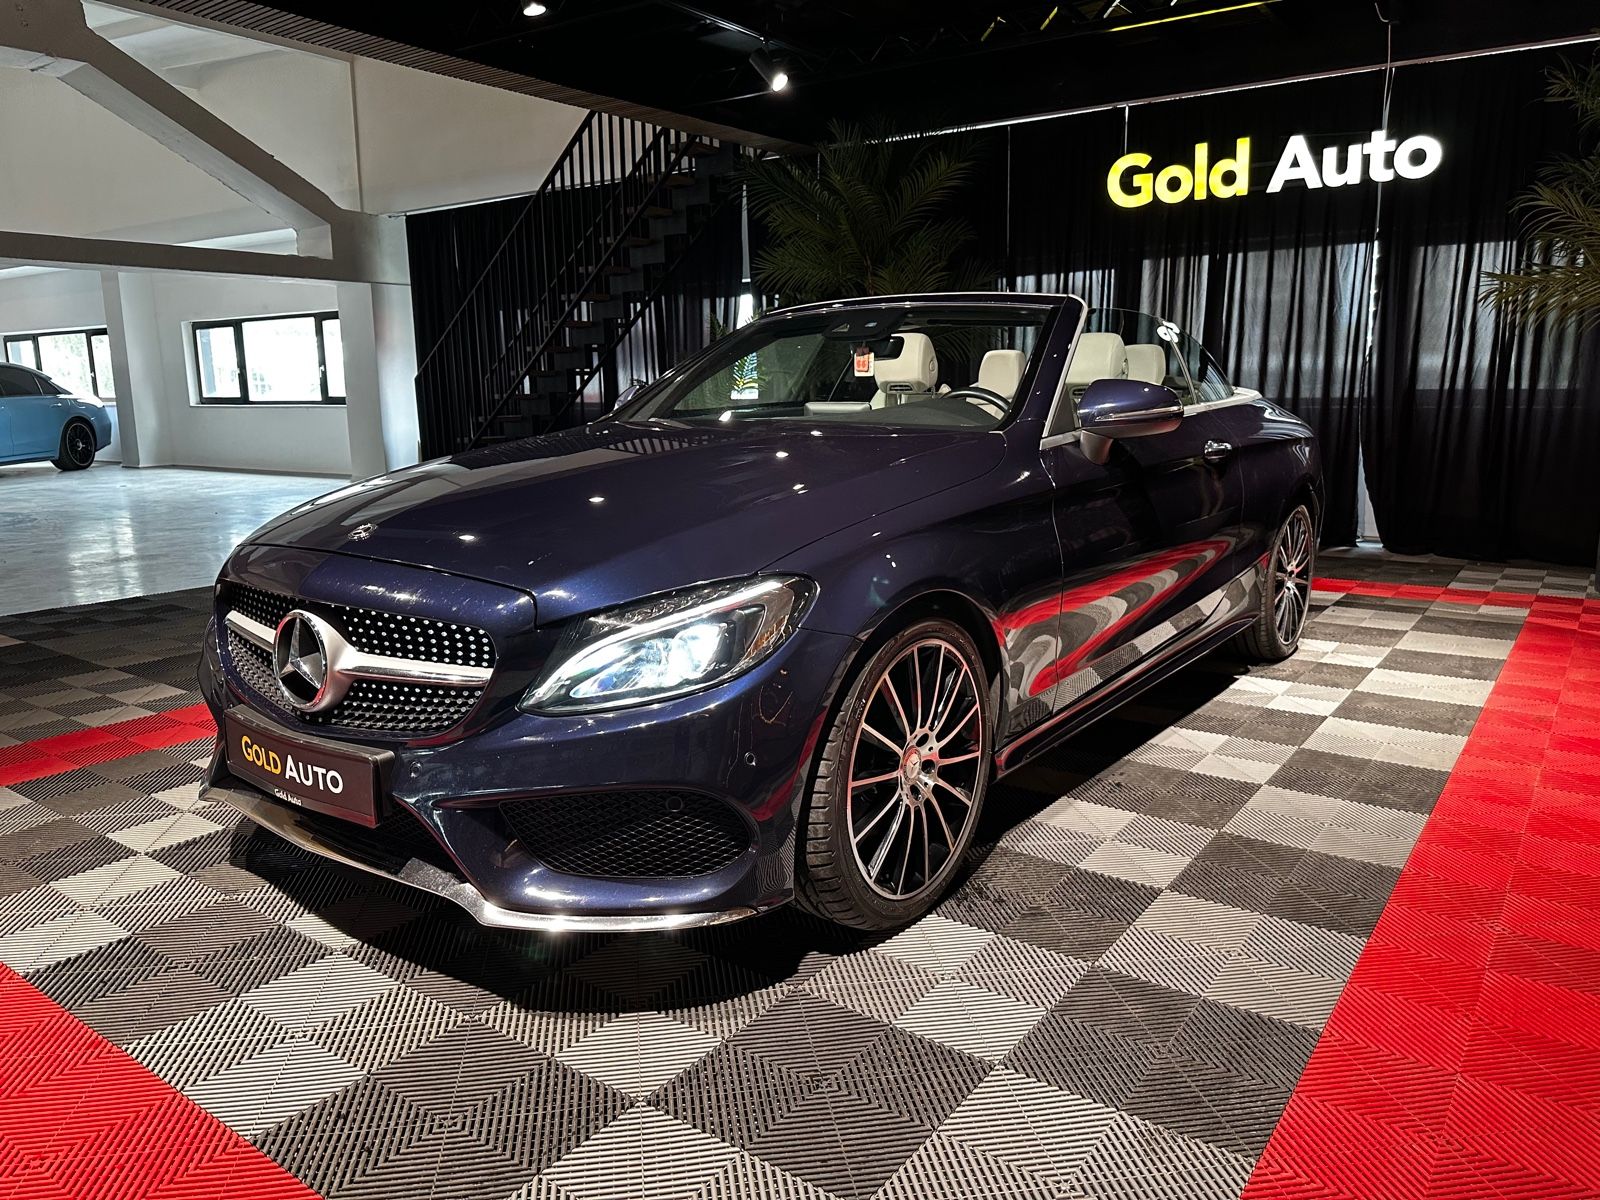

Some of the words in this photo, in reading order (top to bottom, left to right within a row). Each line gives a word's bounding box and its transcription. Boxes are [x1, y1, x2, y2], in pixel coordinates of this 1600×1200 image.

[1107, 137, 1251, 209] Gold
[1266, 129, 1443, 194] Auto
[241, 735, 282, 775] GOLD
[285, 754, 344, 794] AUTO
[274, 788, 288, 801] Gold
[287, 794, 302, 806] Auto
